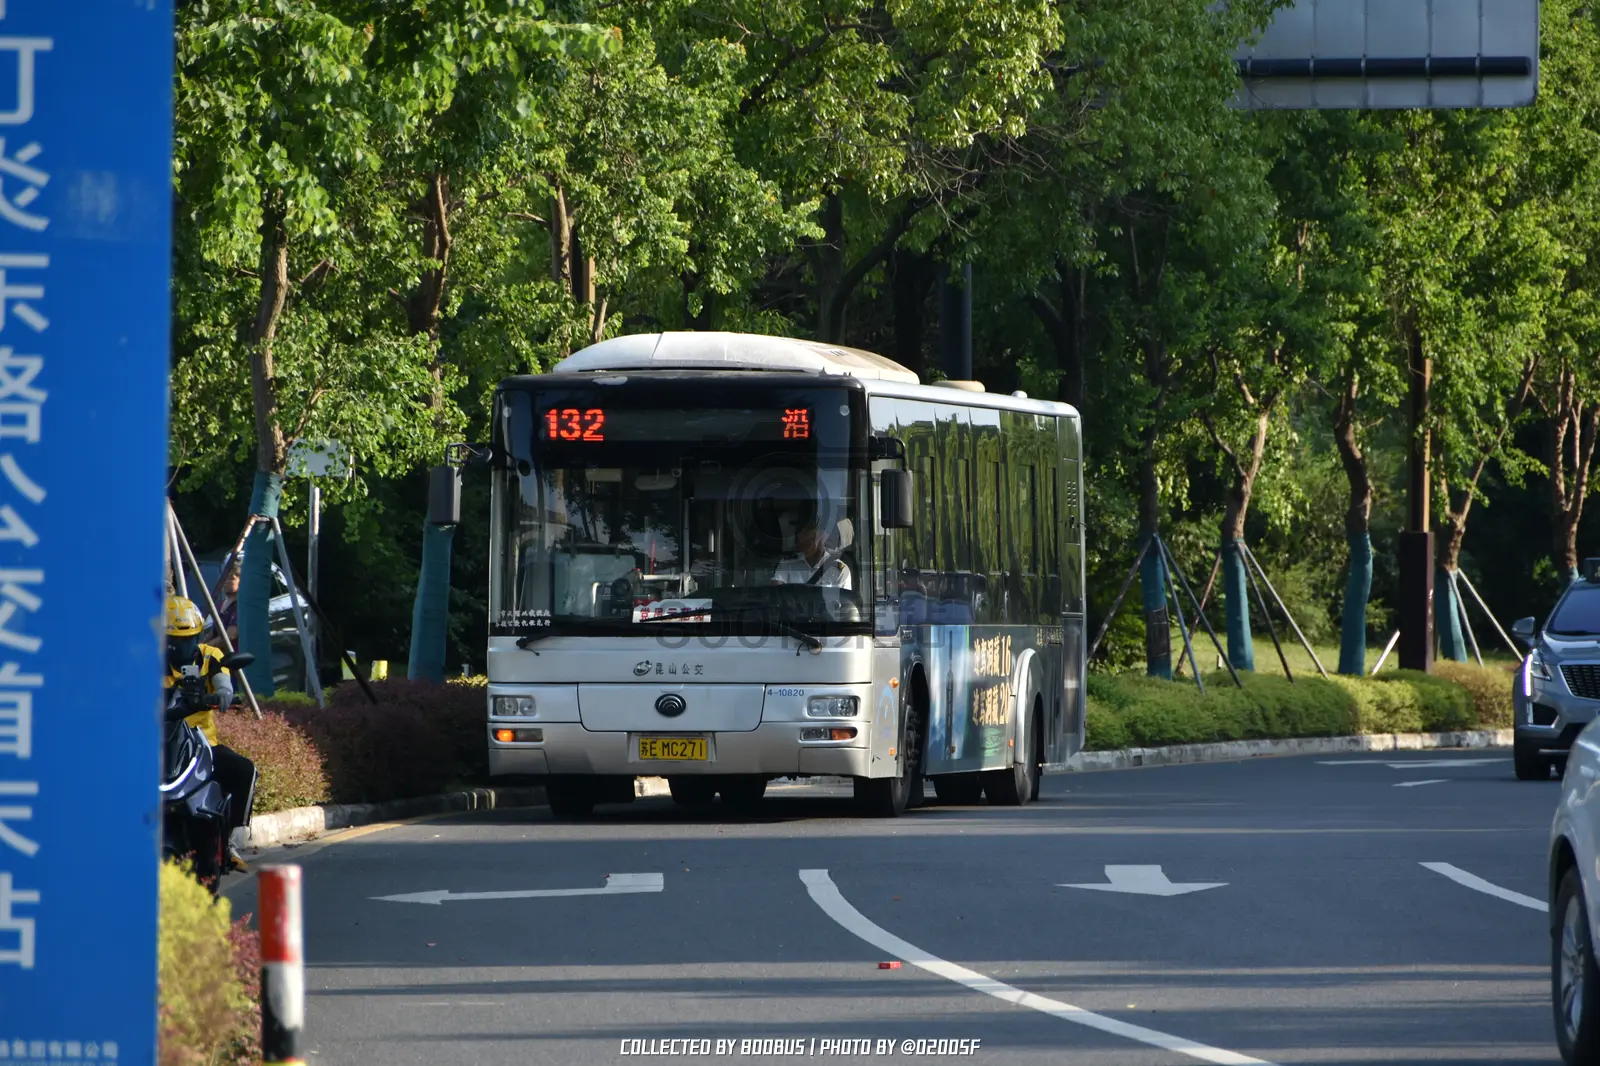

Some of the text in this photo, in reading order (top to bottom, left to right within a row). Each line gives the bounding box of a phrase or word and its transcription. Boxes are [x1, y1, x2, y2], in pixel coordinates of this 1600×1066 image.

[545, 408, 605, 441] 132
[781, 408, 809, 439] 沿
[655, 662, 704, 676] 昆山公交
[767, 688, 805, 697] 4-10820
